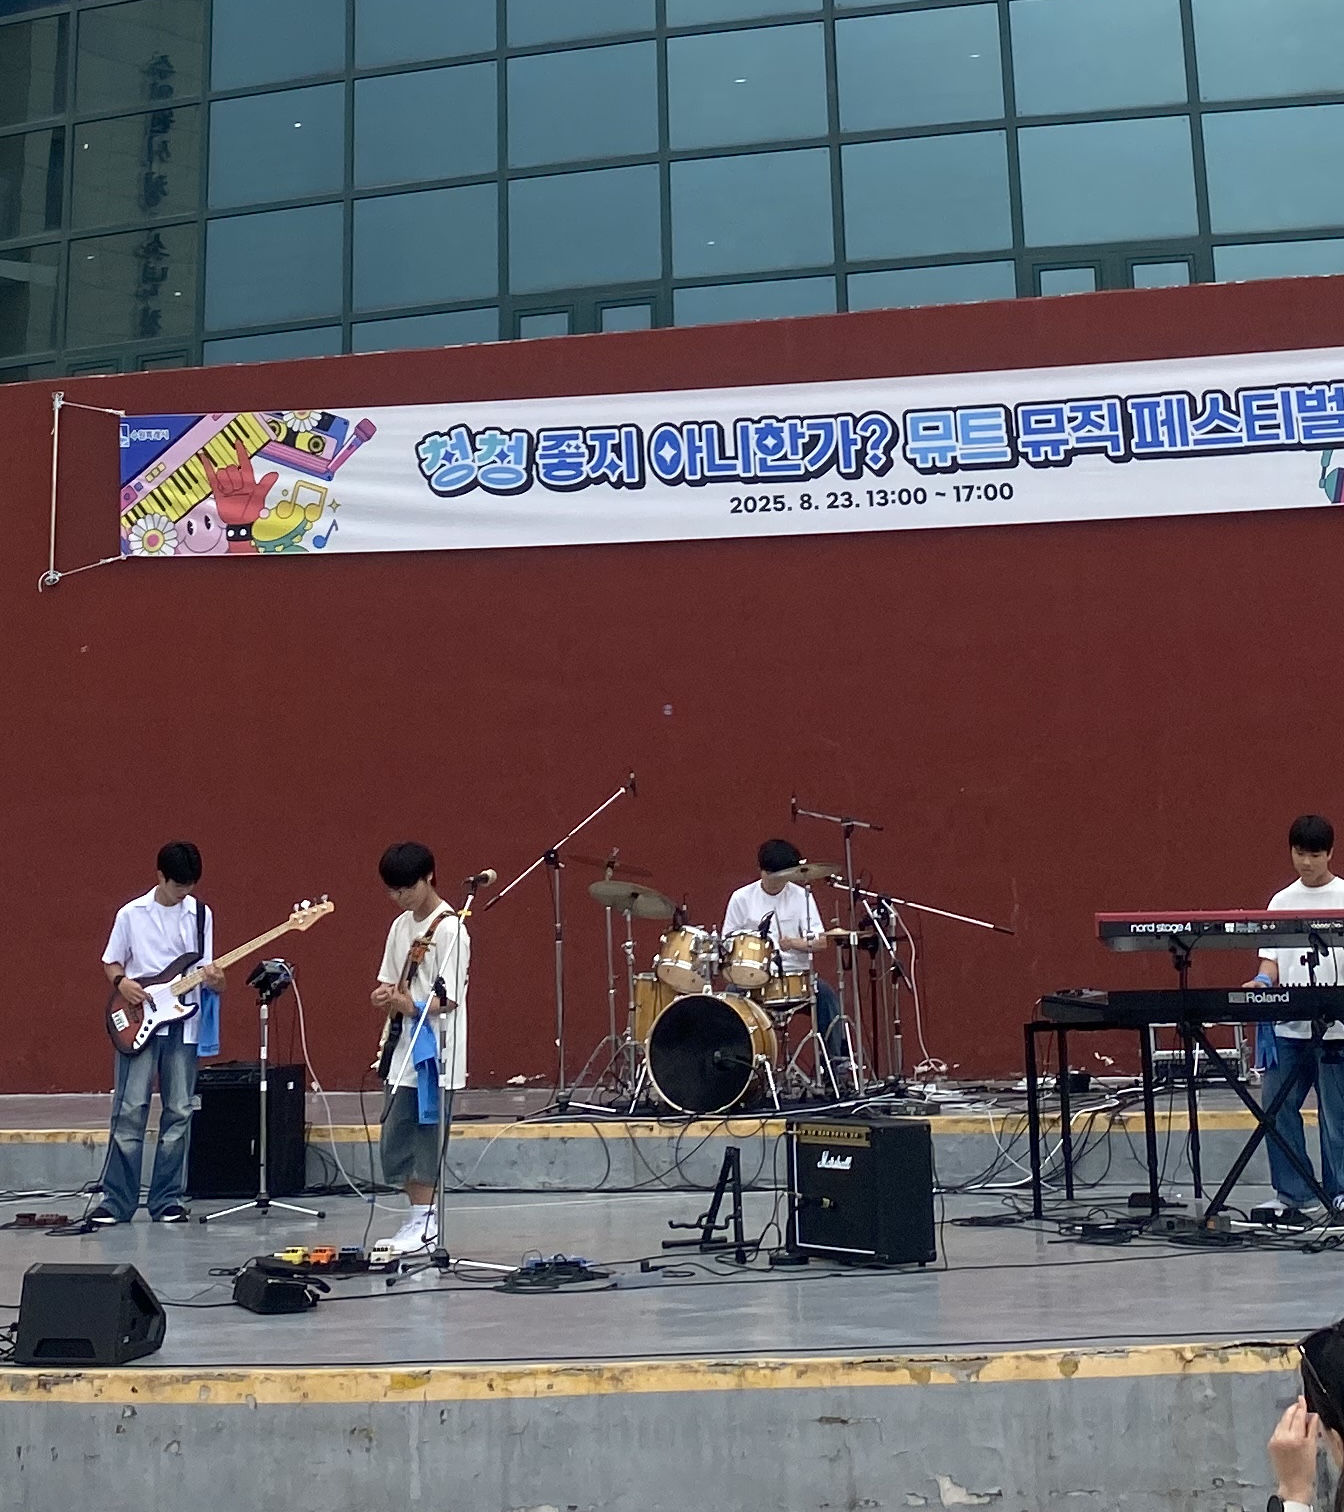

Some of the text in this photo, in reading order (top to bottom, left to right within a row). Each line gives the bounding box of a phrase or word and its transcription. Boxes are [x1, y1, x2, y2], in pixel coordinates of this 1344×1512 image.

[416, 424, 534, 497] 청청
[536, 423, 646, 492] 좋지
[648, 410, 899, 487] 아니한가?
[903, 404, 1018, 475] 뮤트
[1015, 395, 1132, 468] 뮤직
[729, 494, 793, 514] 2025.
[799, 493, 819, 510] 8.
[826, 491, 860, 509] 23.
[866, 487, 927, 507] 13:00
[953, 482, 1014, 502] 17:00
[1130, 922, 1192, 934] nord stage 4
[1246, 991, 1290, 1003] Roland
